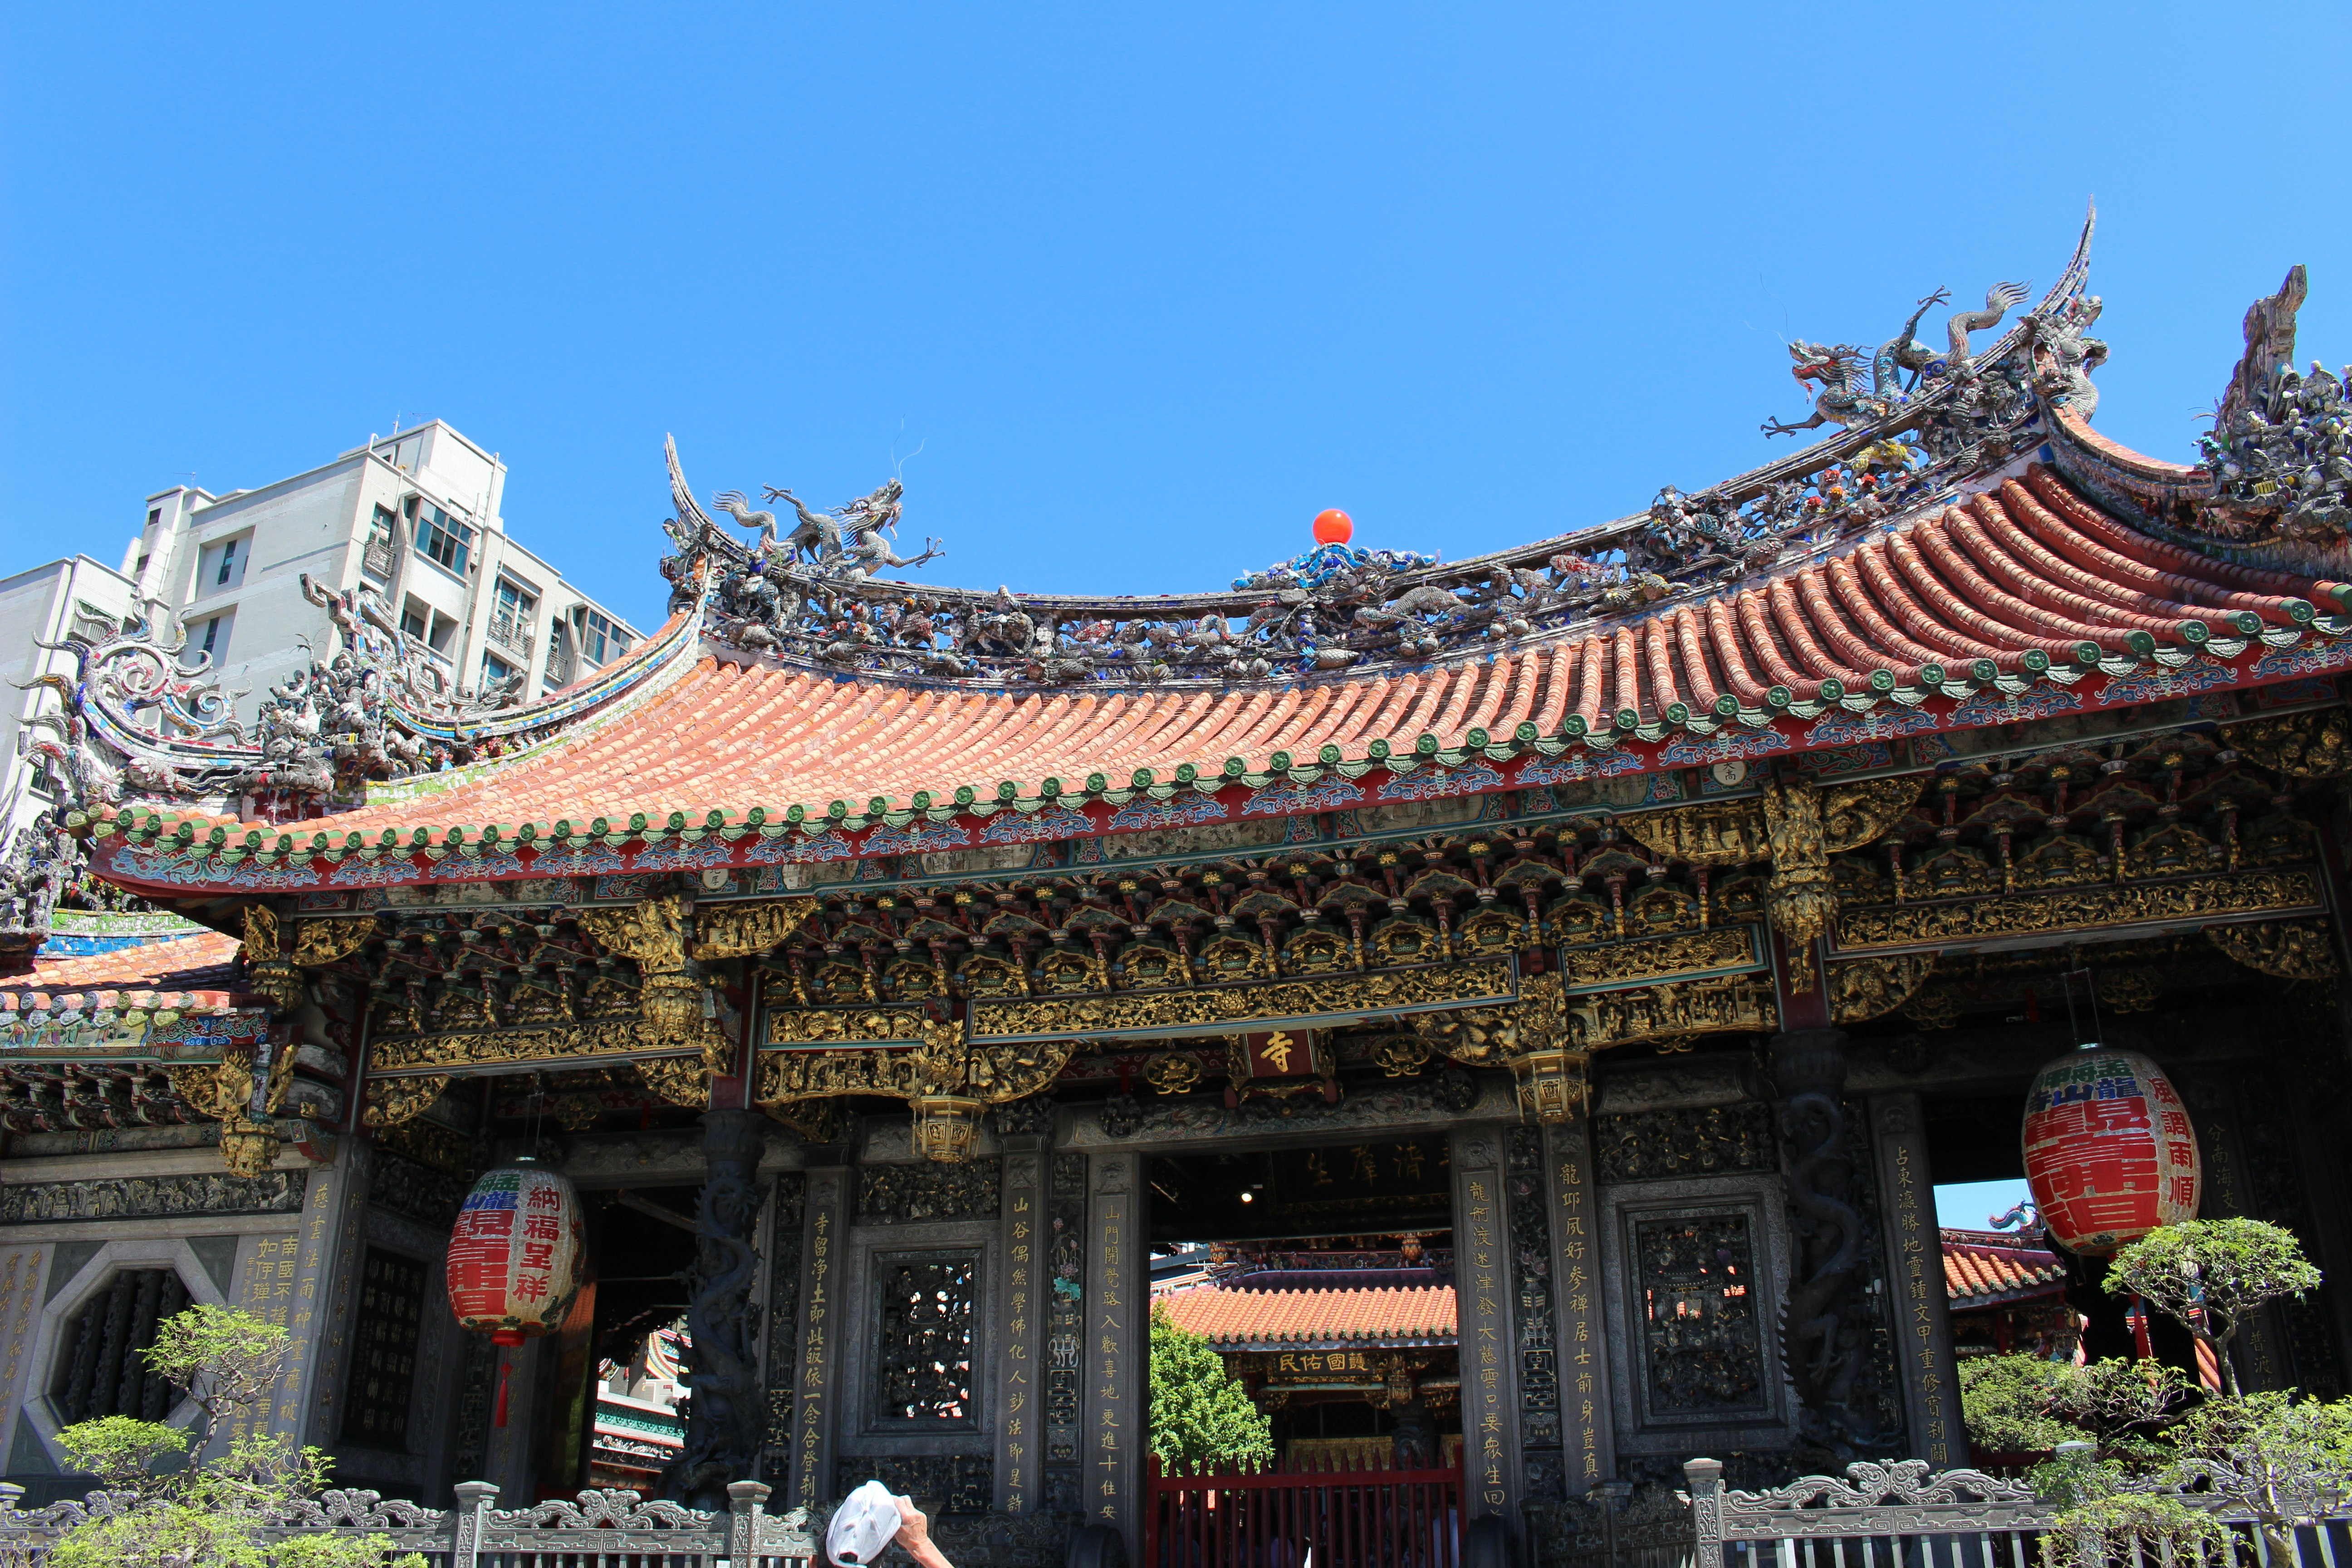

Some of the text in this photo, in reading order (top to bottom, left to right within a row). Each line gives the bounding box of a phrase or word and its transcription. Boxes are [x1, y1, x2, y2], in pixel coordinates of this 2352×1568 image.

[1260, 1031, 1294, 1073] 寺
[2148, 1078, 2194, 1209] 風調雨順
[512, 1186, 561, 1303] 納福呈祥
[1279, 1352, 1370, 1372] 護國佑民
